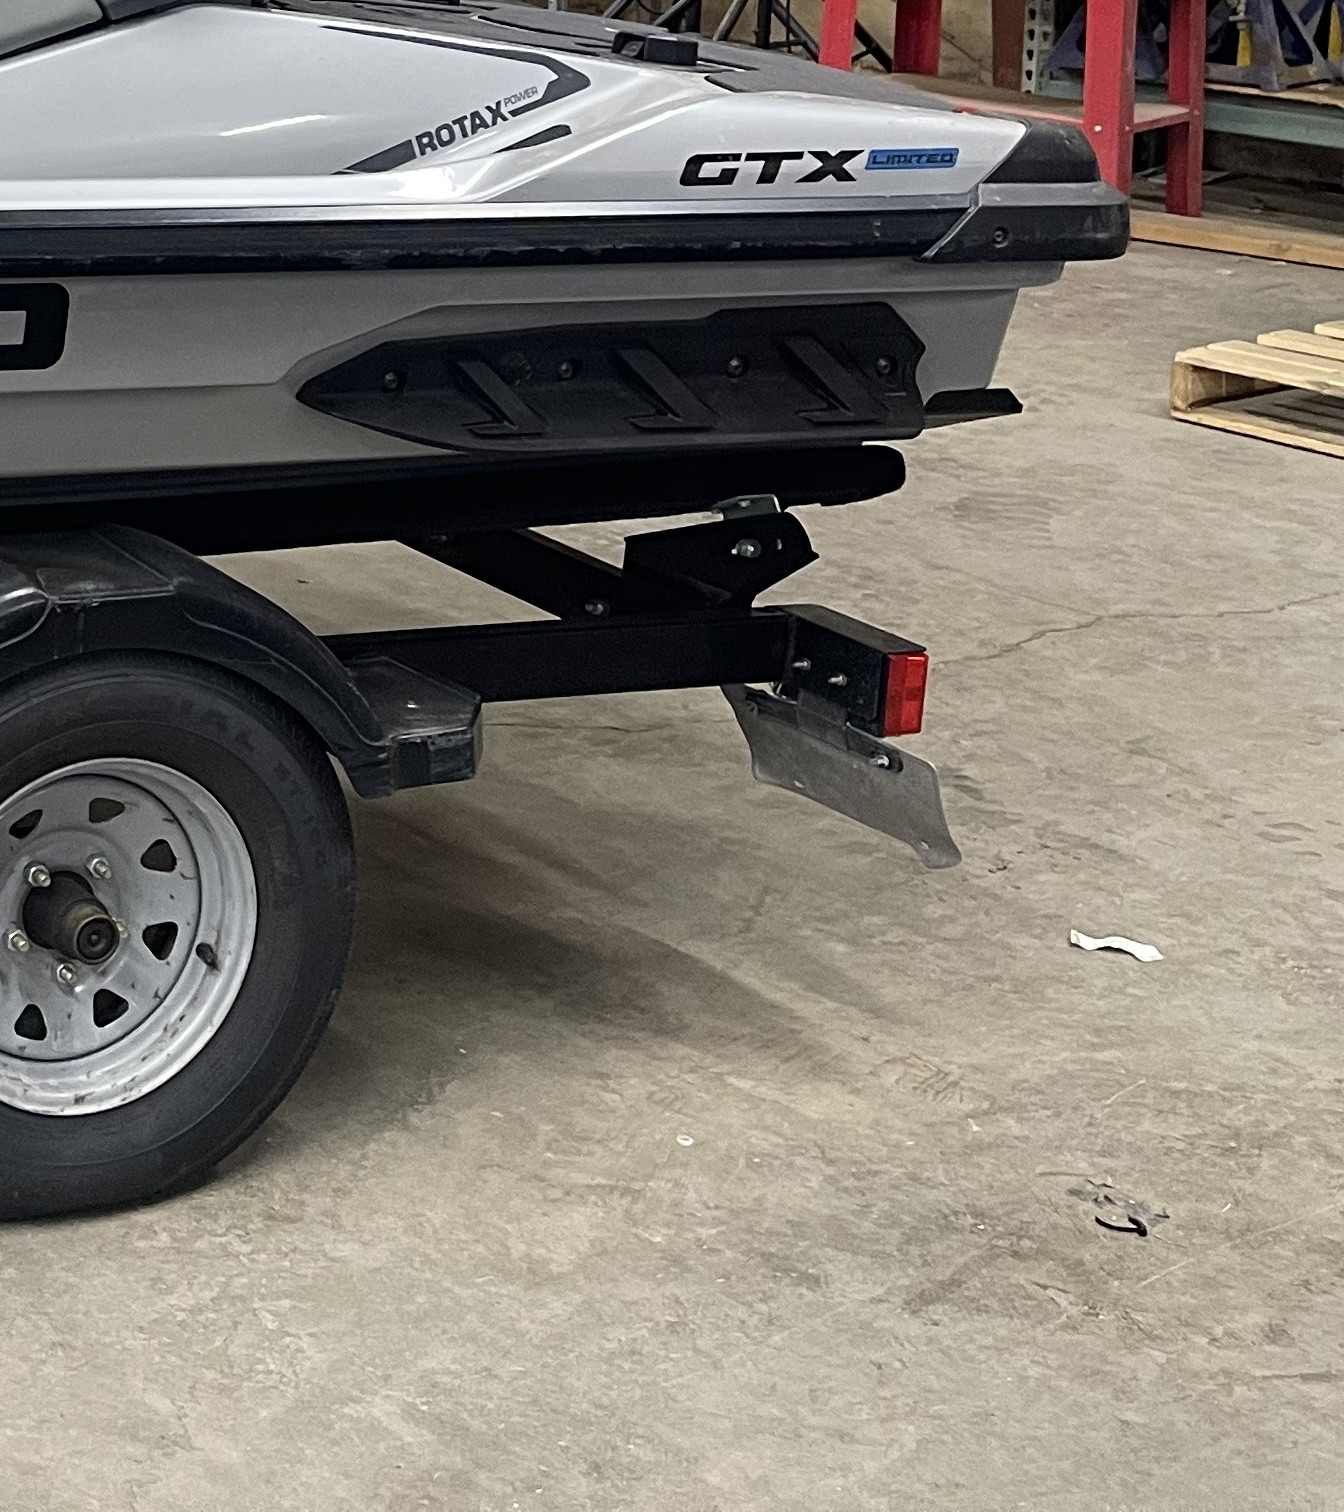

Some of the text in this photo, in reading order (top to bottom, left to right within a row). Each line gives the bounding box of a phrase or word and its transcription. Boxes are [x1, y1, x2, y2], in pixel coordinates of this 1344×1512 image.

[415, 85, 539, 156] ROTAX POWER
[679, 149, 954, 187] GTX LIMITED
